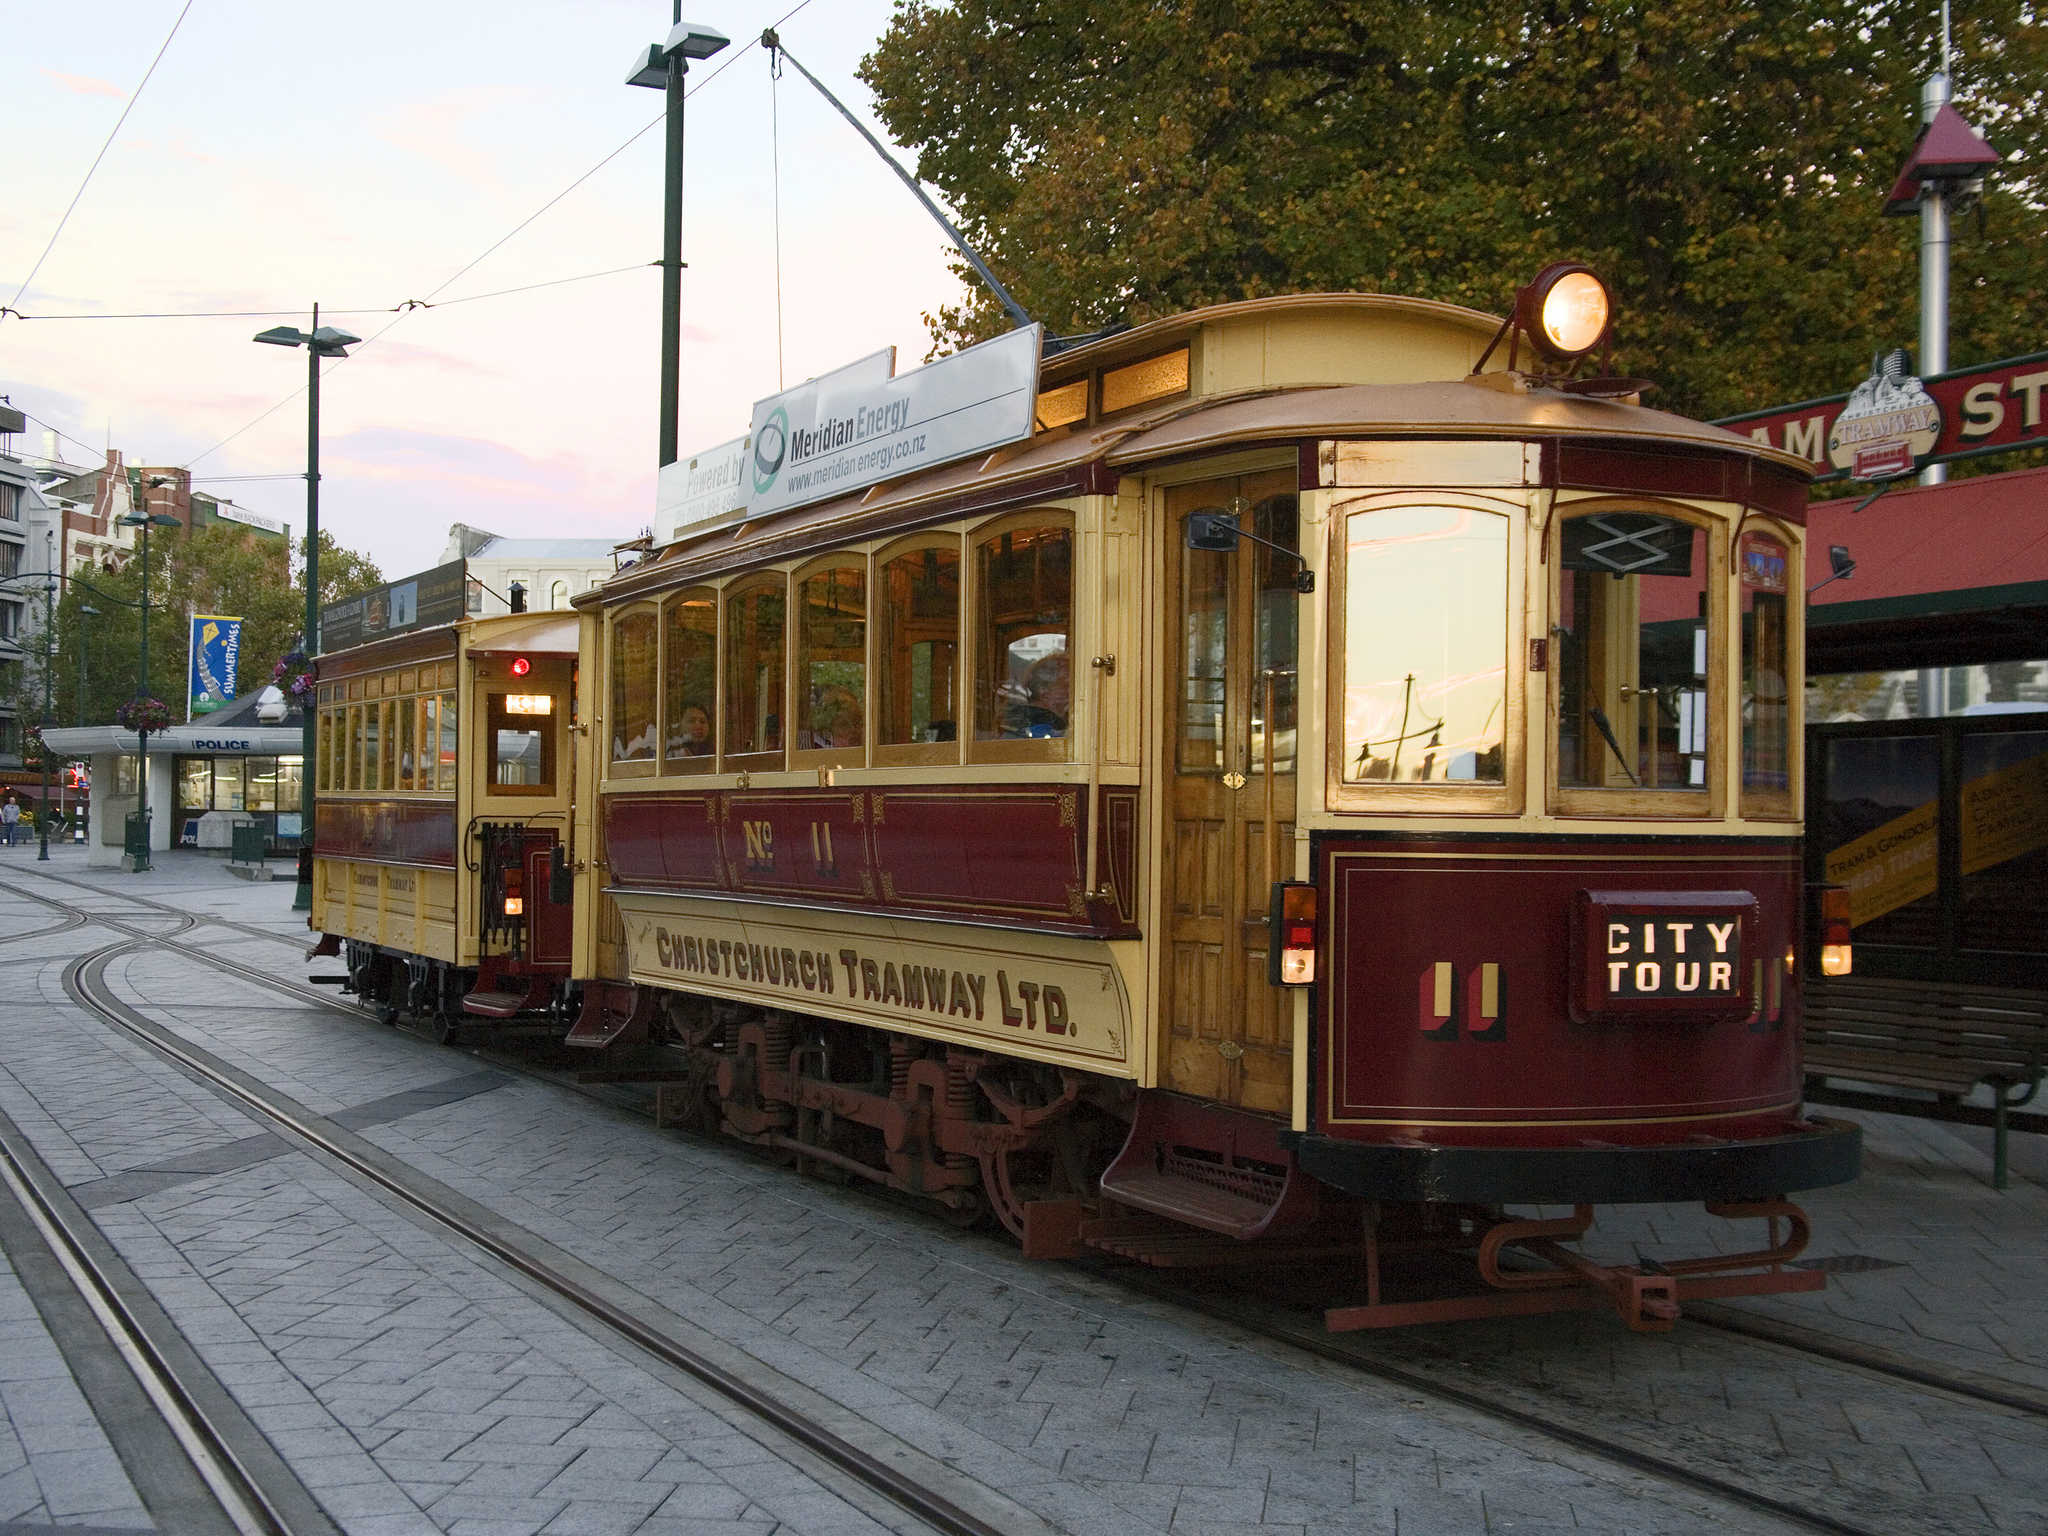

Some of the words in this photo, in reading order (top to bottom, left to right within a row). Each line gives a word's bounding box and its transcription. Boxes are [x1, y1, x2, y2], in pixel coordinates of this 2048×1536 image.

[791, 417, 854, 462] Meridian
[856, 397, 910, 434] Energy
[1839, 409, 1933, 444] TRAMWAY
[686, 456, 730, 499] Powered
[731, 452, 746, 486] by
[223, 623, 241, 695] SUMMERTIMES
[195, 739, 249, 751] POLICE
[1829, 852, 1866, 876] TRAM
[1866, 845, 1878, 860] &
[1888, 838, 1937, 876] TICKE
[1607, 922, 1735, 955] CITY
[656, 926, 835, 994] CHRISTCHURCH
[840, 948, 987, 1021] TRAMWAY
[997, 969, 1078, 1038] LTD.
[1431, 961, 1500, 1020] 11
[1607, 961, 1732, 992] TOUR
